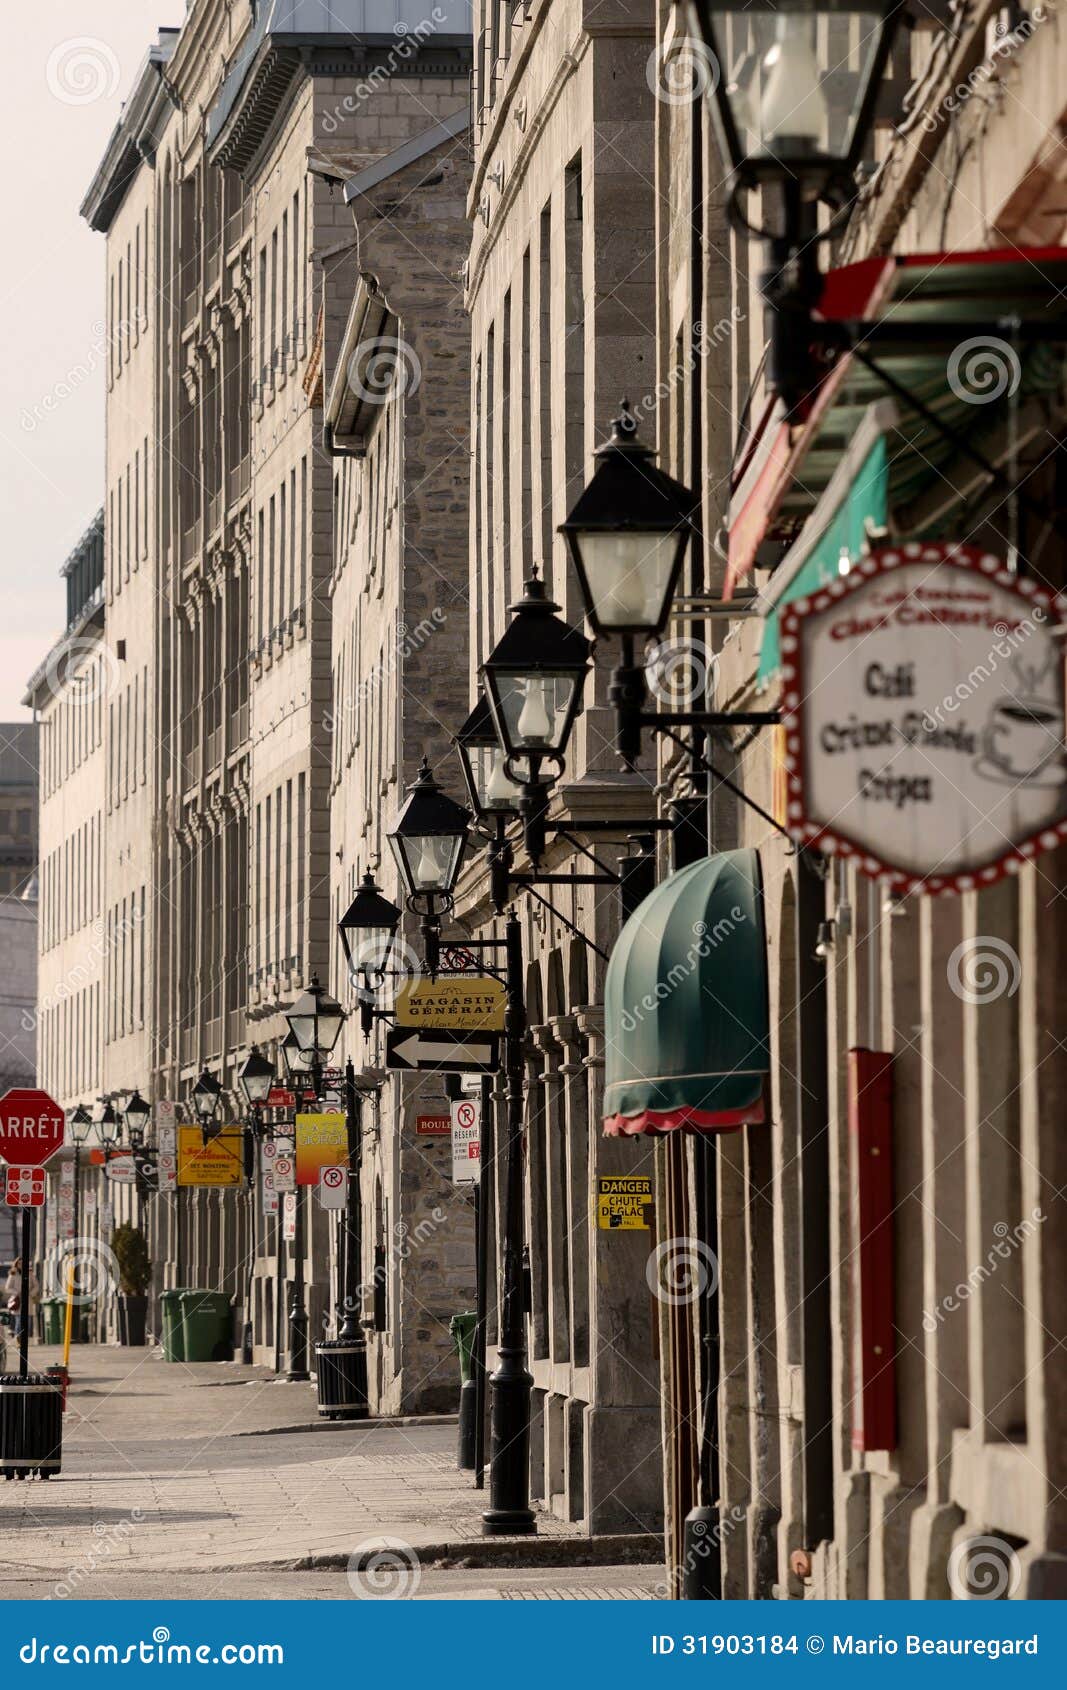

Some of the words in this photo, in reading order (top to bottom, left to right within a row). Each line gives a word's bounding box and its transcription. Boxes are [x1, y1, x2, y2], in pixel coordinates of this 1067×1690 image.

[409, 996, 495, 1006] MAGASIN
[601, 1181, 650, 1193] DANGER
[609, 1196, 642, 1206] CHUTE
[601, 1206, 615, 1216] DE
[617, 1206, 644, 1216] GLAC
